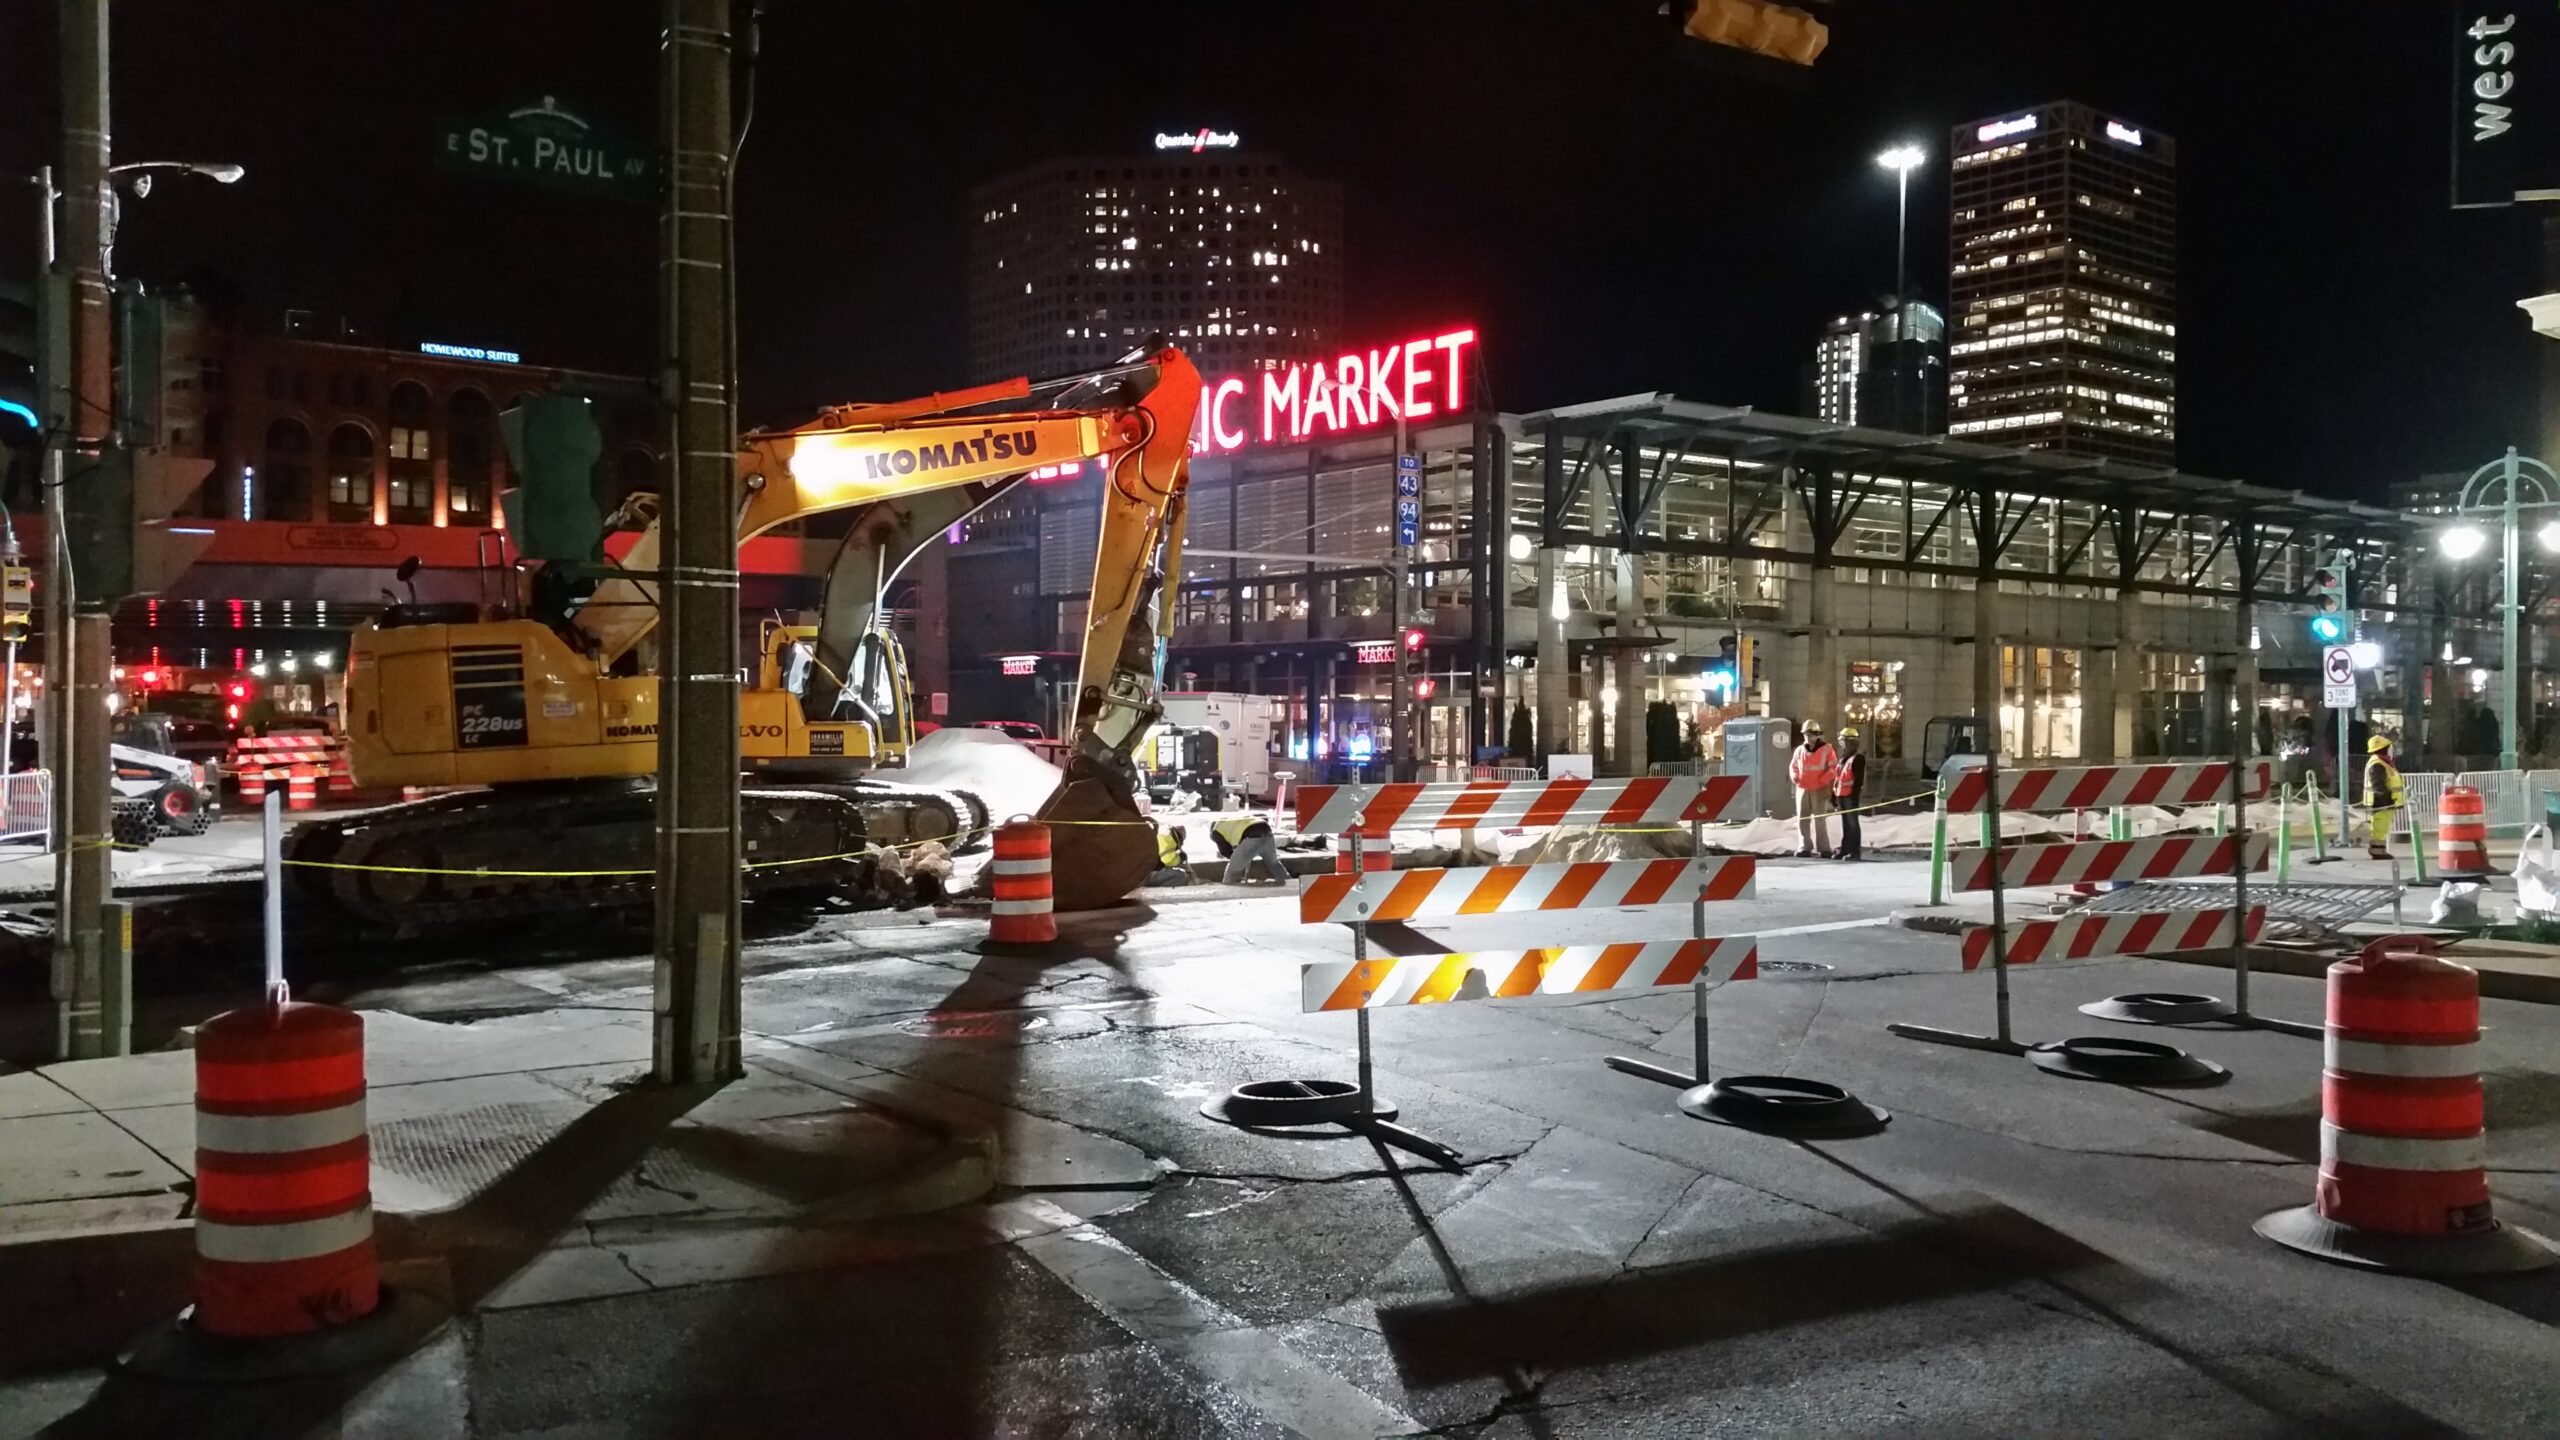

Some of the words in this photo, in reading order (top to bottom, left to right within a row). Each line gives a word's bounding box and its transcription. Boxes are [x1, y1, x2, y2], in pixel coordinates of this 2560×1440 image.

[2466, 13, 2516, 142] west
[447, 133, 459, 151] E
[624, 158, 645, 176] AV
[421, 343, 485, 359] HOMEWOOD
[486, 350, 520, 363] SUITES
[1263, 330, 1474, 442] MARKET
[865, 429, 1037, 479] KOMATSU
[1404, 459, 1415, 467] TO
[1401, 477, 1417, 491] 43
[1401, 503, 1416, 518] 94
[1003, 660, 1036, 675] MARKET
[2328, 691, 2334, 702] 3
[462, 704, 484, 716] PC
[465, 734, 480, 744] LC
